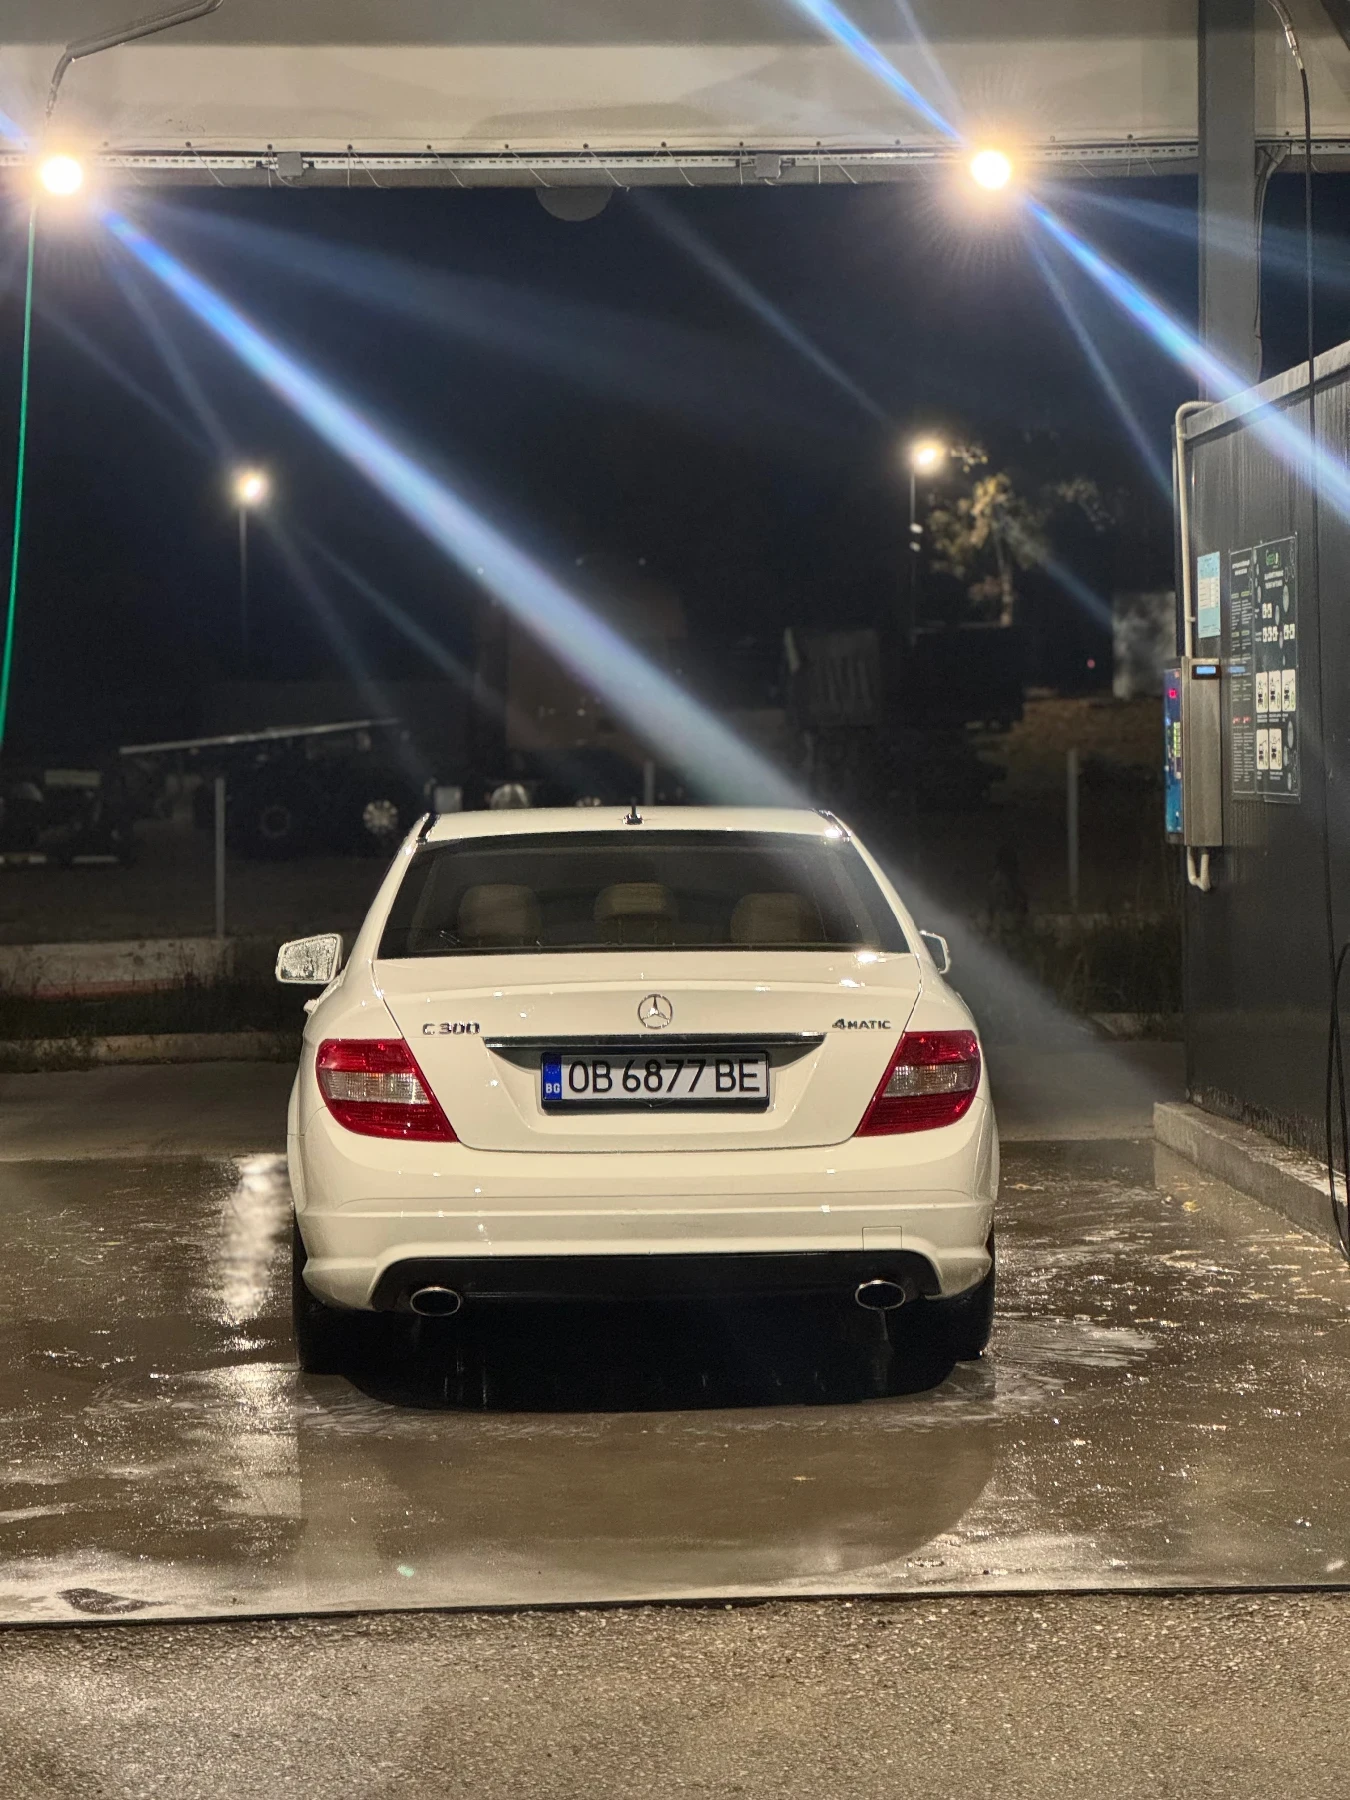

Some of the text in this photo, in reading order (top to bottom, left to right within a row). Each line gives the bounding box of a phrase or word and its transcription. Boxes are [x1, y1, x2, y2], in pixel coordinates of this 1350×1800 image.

[832, 1018, 891, 1030] 4MATIC
[568, 1058, 760, 1093] OB 6877 BE
[545, 1083, 561, 1094] BG
